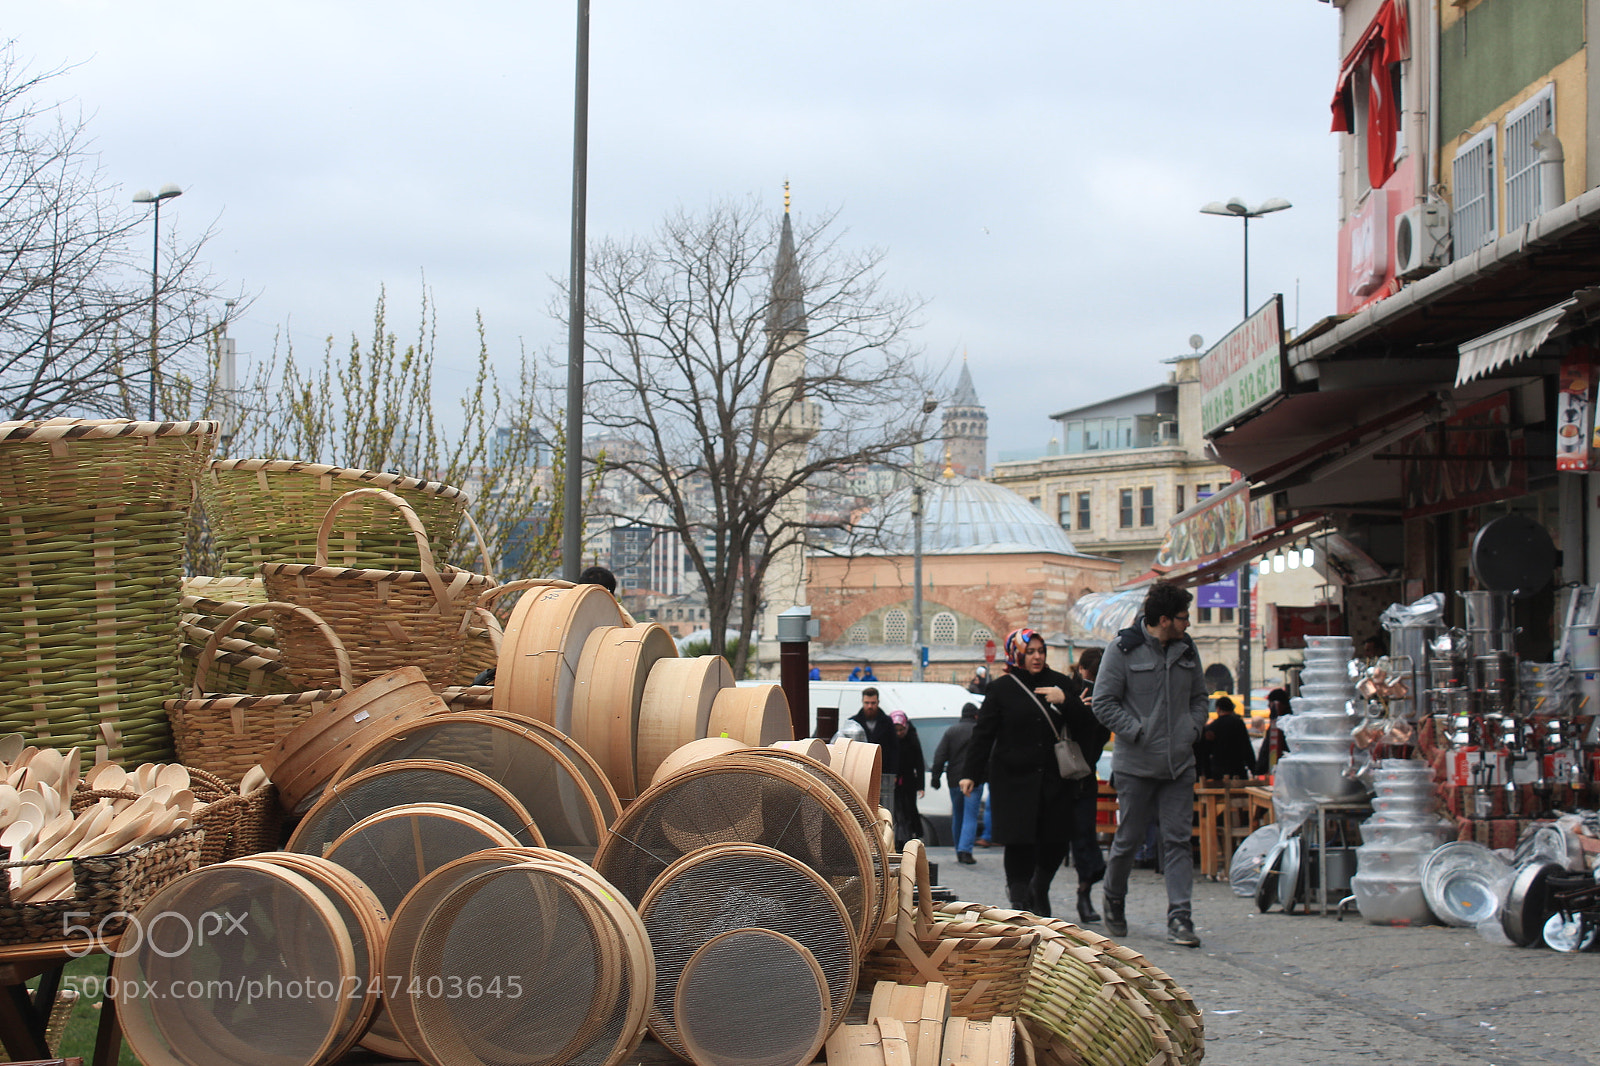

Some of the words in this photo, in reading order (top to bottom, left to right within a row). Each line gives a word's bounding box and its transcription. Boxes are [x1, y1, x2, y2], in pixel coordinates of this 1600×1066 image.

[1239, 372, 1256, 409] 512
[1256, 363, 1268, 398] 62
[1269, 355, 1280, 390] 37
